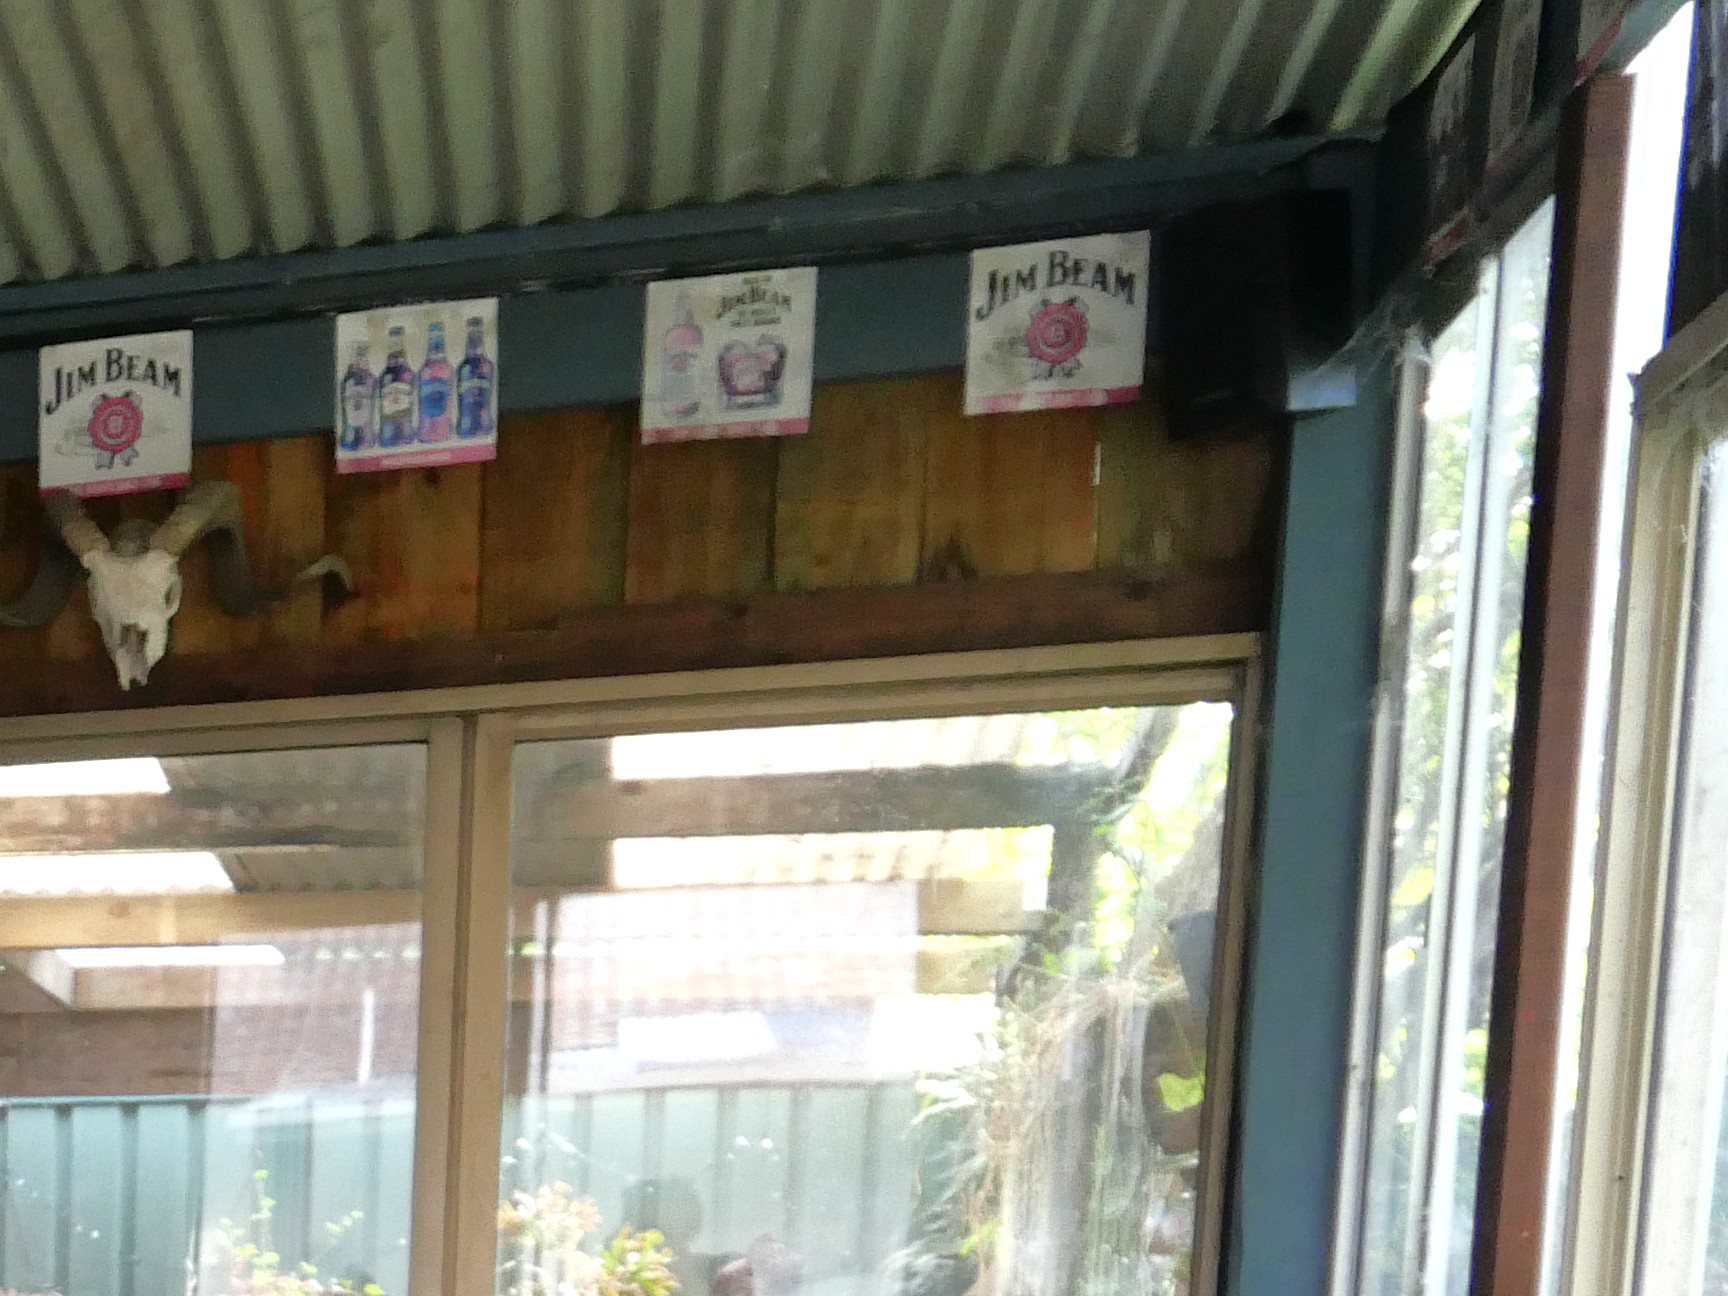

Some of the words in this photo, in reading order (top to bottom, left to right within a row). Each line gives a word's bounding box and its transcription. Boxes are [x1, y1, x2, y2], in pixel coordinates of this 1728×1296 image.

[976, 263, 1037, 321] JIM
[1047, 250, 1135, 305] BEAM
[45, 361, 96, 415] JIM
[106, 348, 181, 397] BEAM
